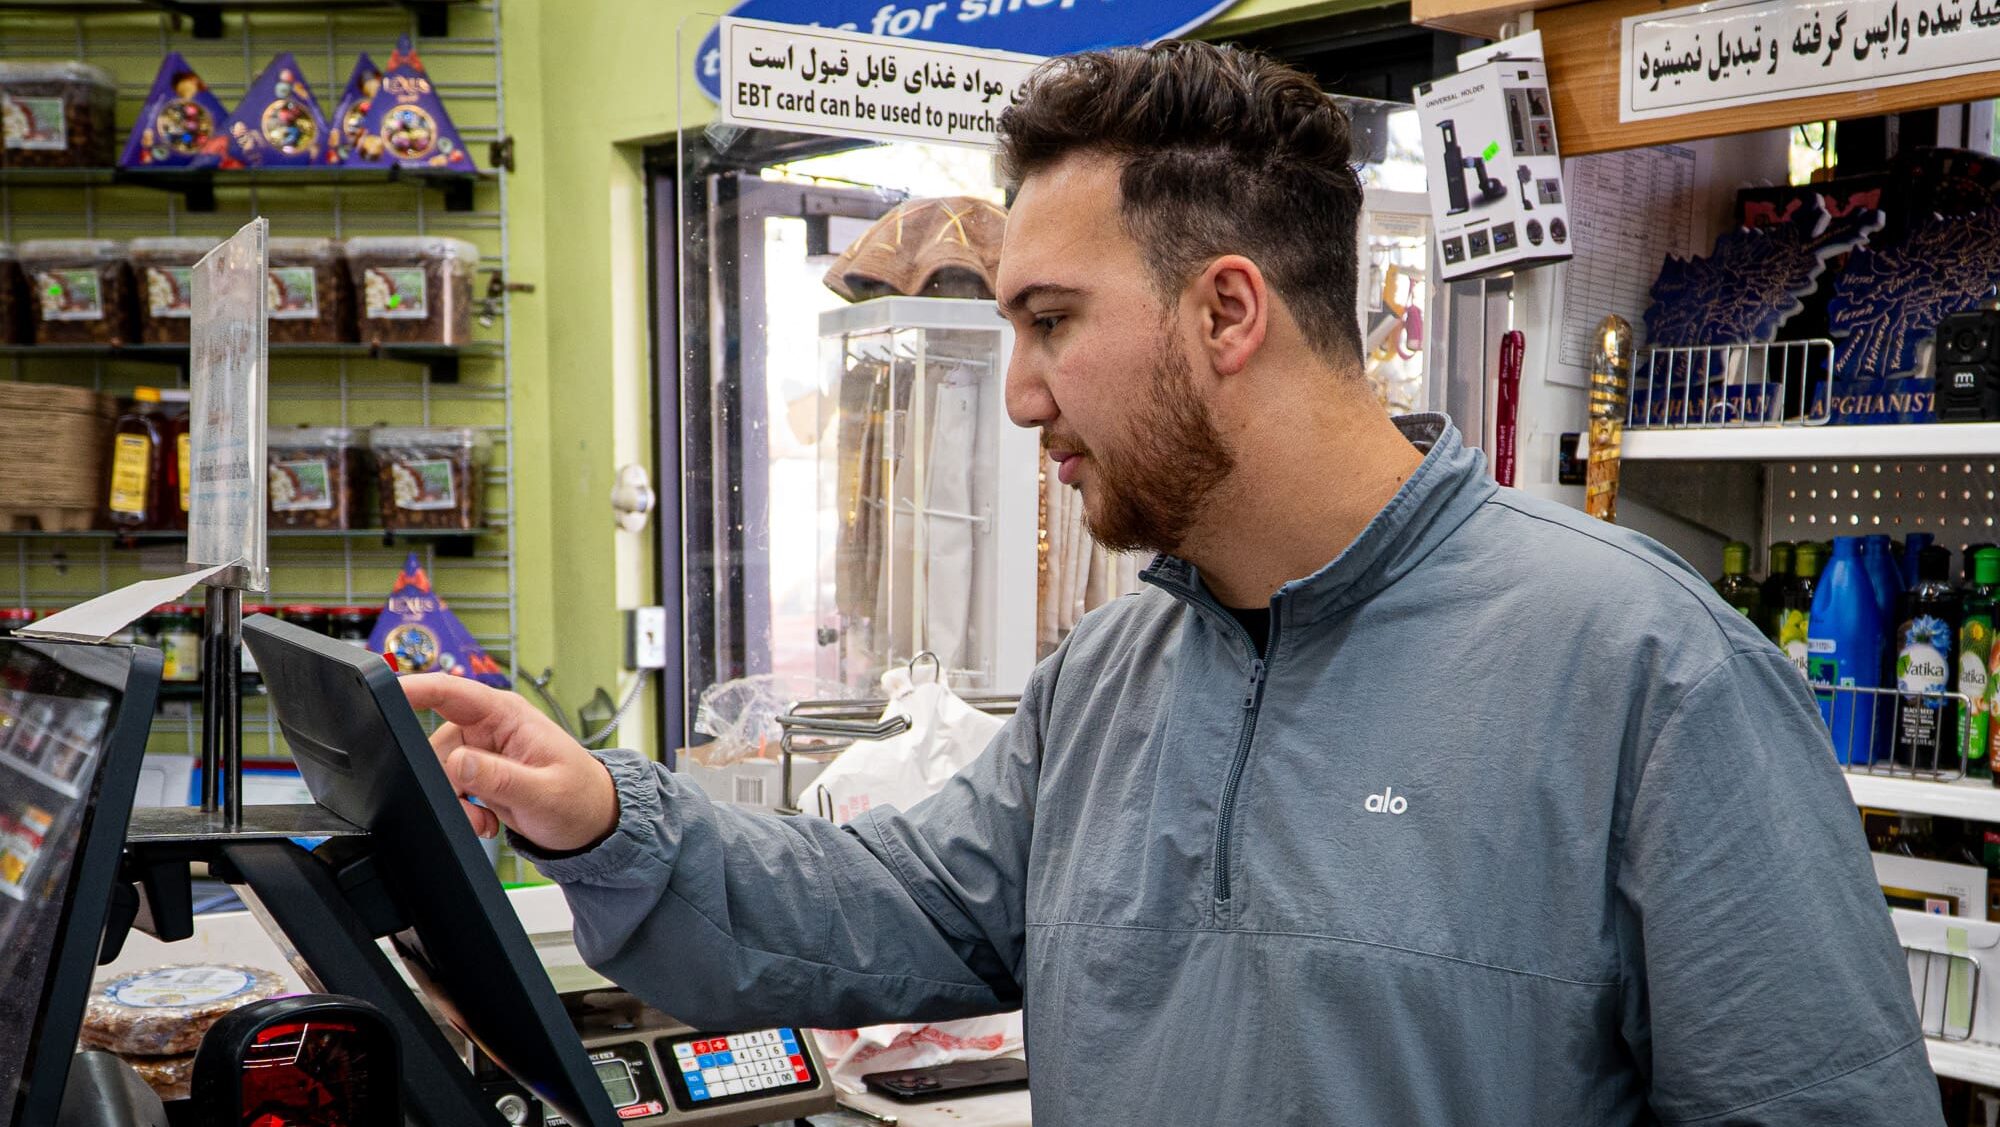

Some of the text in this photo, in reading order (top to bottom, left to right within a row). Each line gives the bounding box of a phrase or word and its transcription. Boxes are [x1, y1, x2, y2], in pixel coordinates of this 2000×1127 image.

[872, 3, 947, 36] for
[1853, 1, 1910, 60] واپس
[1708, 25, 1762, 82] تبدیل
[1793, 10, 1848, 66] گرفته
[749, 44, 794, 71] است
[801, 47, 849, 84] قبول
[856, 55, 897, 88] قابل
[1639, 34, 1703, 91] نمیشود
[904, 63, 956, 94] غذای
[963, 69, 1004, 103] مواد
[1461, 83, 1486, 98] HOLDER
[738, 82, 771, 107] EBT
[777, 89, 815, 113] card
[820, 98, 850, 117] can
[855, 95, 876, 119] be
[881, 102, 921, 125] used
[926, 106, 943, 127] to
[1904, 660, 1944, 677] Vatika
[1365, 787, 1408, 815] alo
